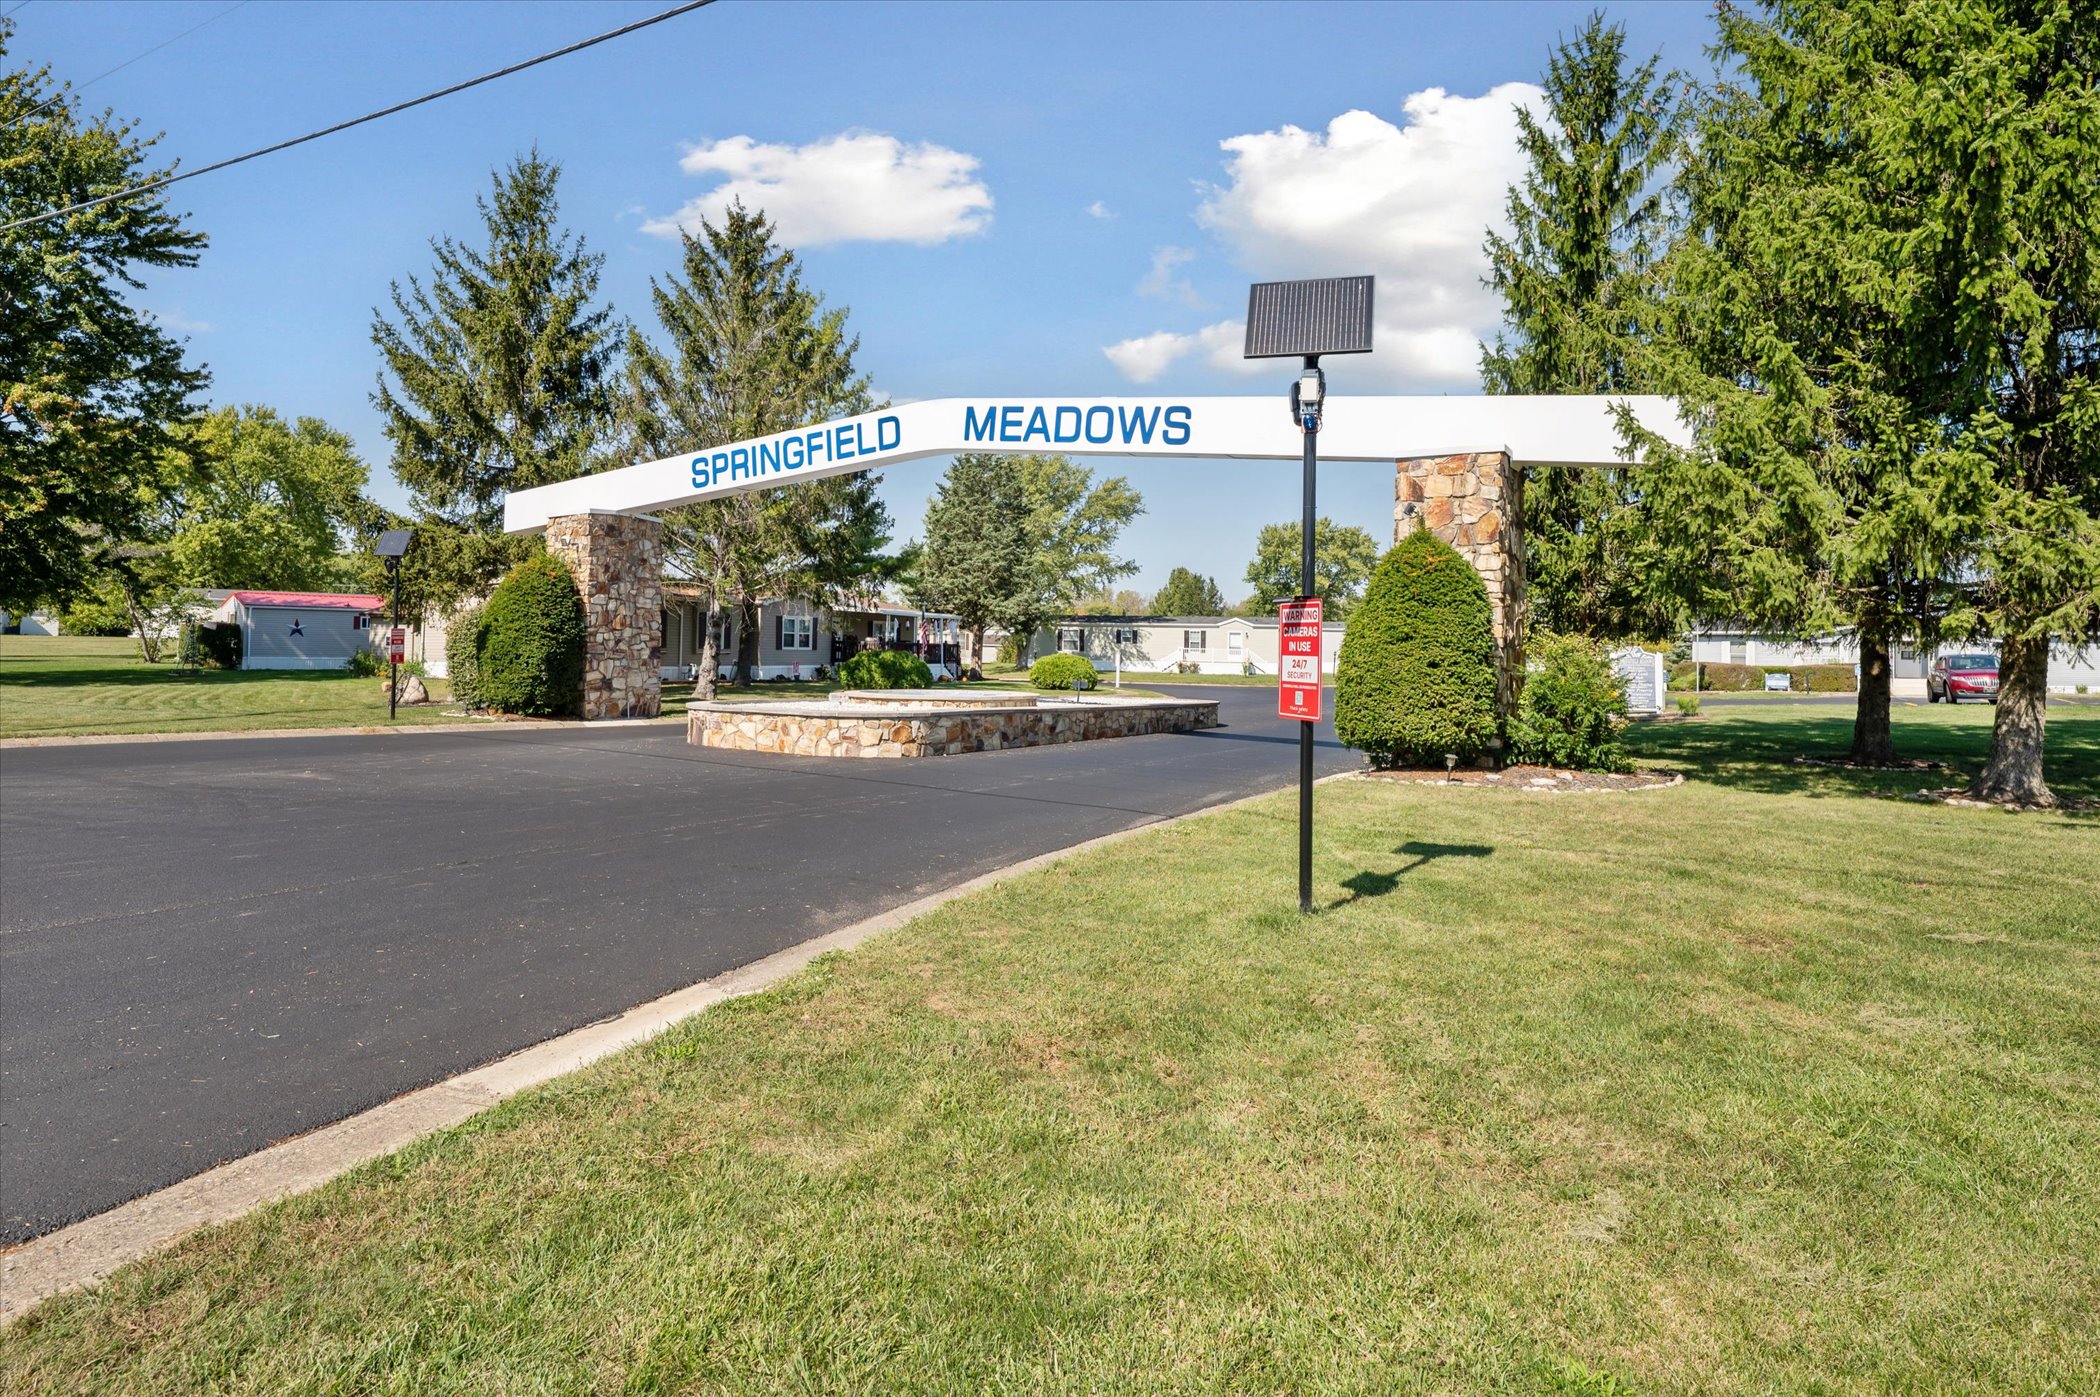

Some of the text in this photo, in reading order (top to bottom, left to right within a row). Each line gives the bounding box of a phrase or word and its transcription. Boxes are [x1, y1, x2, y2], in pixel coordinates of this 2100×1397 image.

[691, 405, 1192, 489] SPRINGFIELD MEADOWS
[1283, 609, 1318, 621] WARNING
[1283, 626, 1318, 637] CAMERAS
[1288, 641, 1312, 652] IN USE
[1292, 659, 1308, 670] 24/7
[1287, 671, 1312, 680] SECURITY
